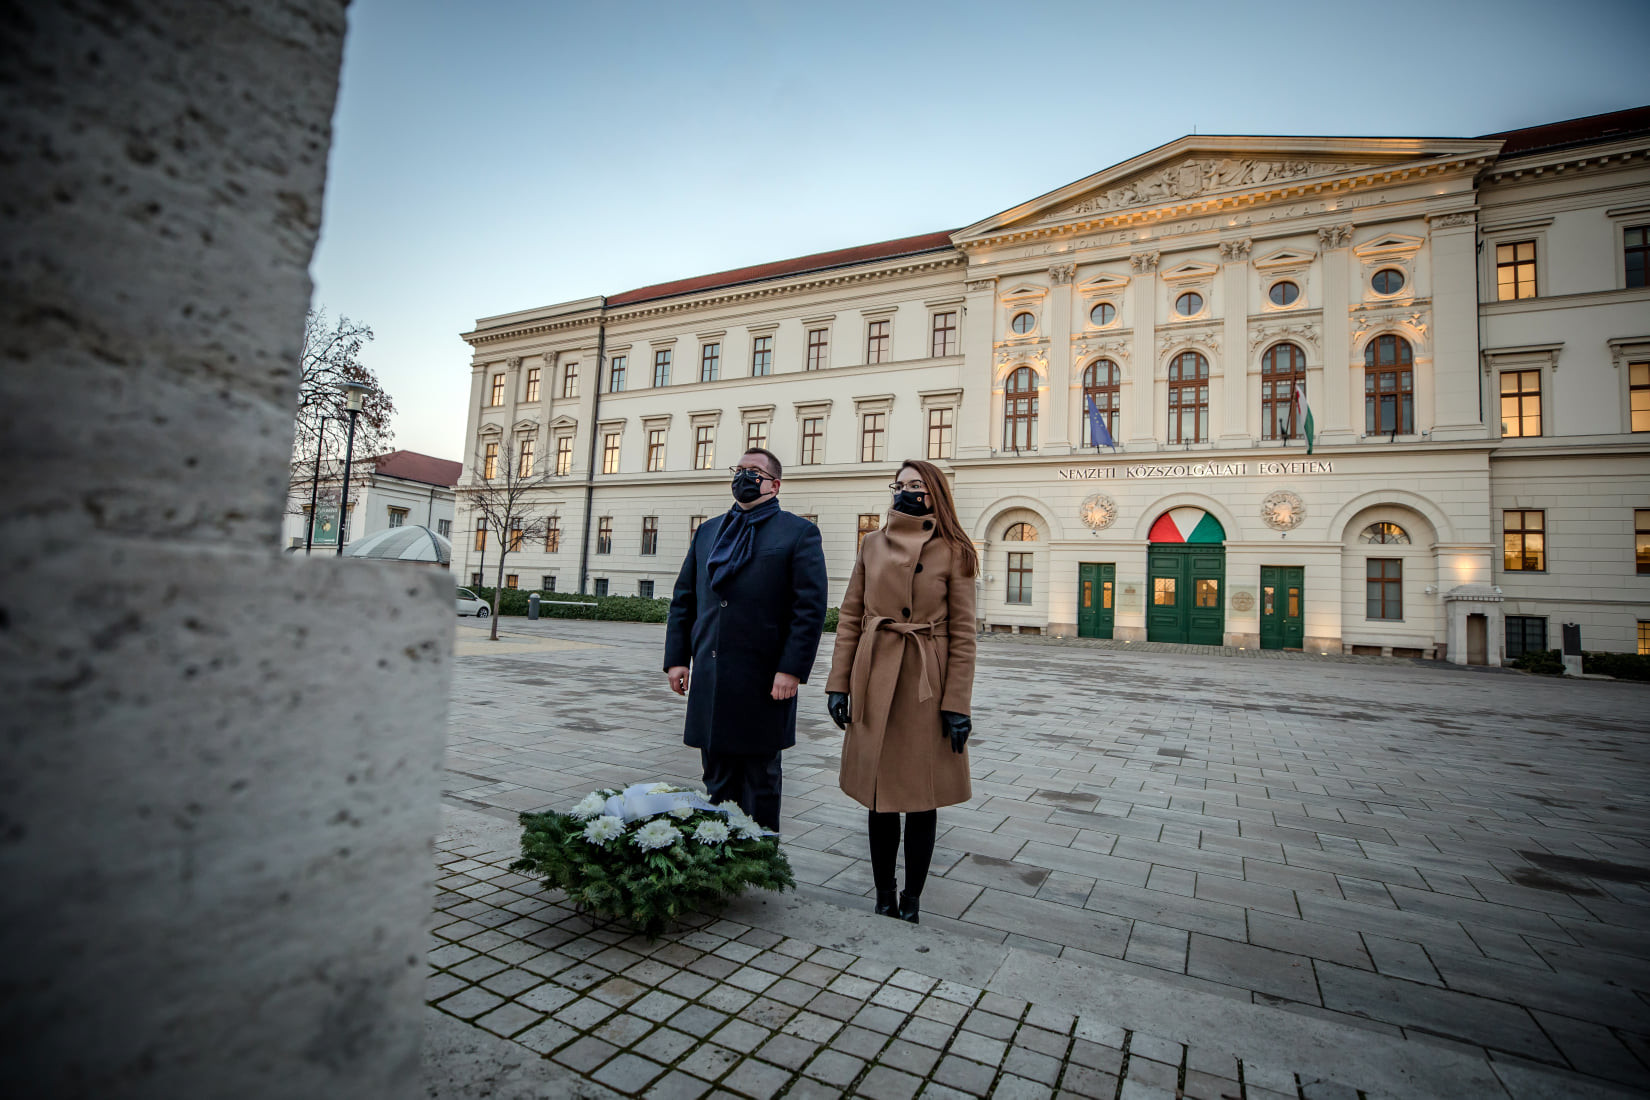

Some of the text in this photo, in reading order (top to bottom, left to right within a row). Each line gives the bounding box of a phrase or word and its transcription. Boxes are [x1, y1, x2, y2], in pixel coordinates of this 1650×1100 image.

[1059, 460, 1333, 480] NEMZETI KÖZSZOLGÁLATI EGYETEM
